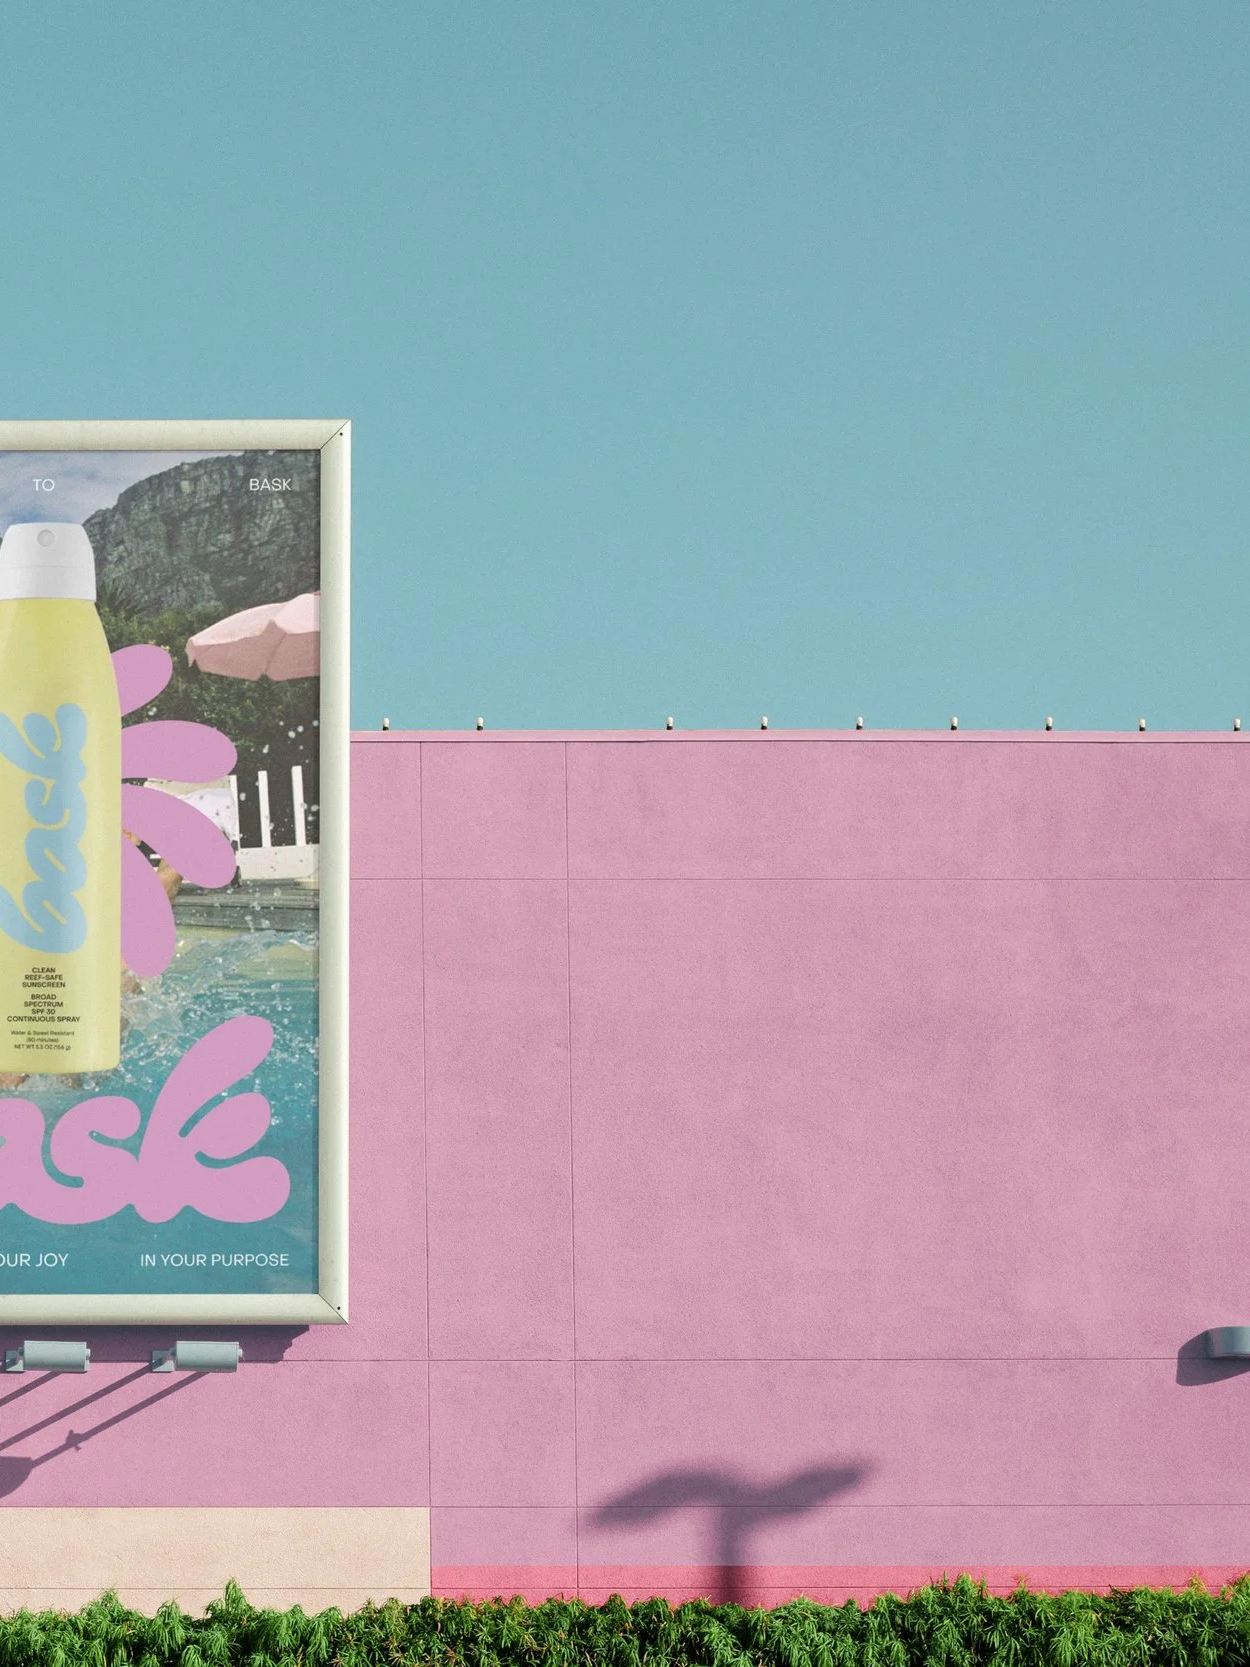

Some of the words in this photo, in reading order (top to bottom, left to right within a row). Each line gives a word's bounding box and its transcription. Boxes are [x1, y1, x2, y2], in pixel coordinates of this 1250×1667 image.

[32, 479, 55, 492] TO
[249, 478, 291, 492] BASK
[21, 981, 66, 989] SUNSCREEN
[30, 993, 57, 1001] BROAD
[46, 1008, 56, 1016] 30
[6, 1015, 56, 1023] CONTINUOUS
[56, 1015, 81, 1023] SPRAY
[35, 1253, 69, 1268] JOY
[140, 1254, 156, 1267] IN
[160, 1254, 207, 1267] YOUR
[211, 1254, 290, 1267] PURPOSE
